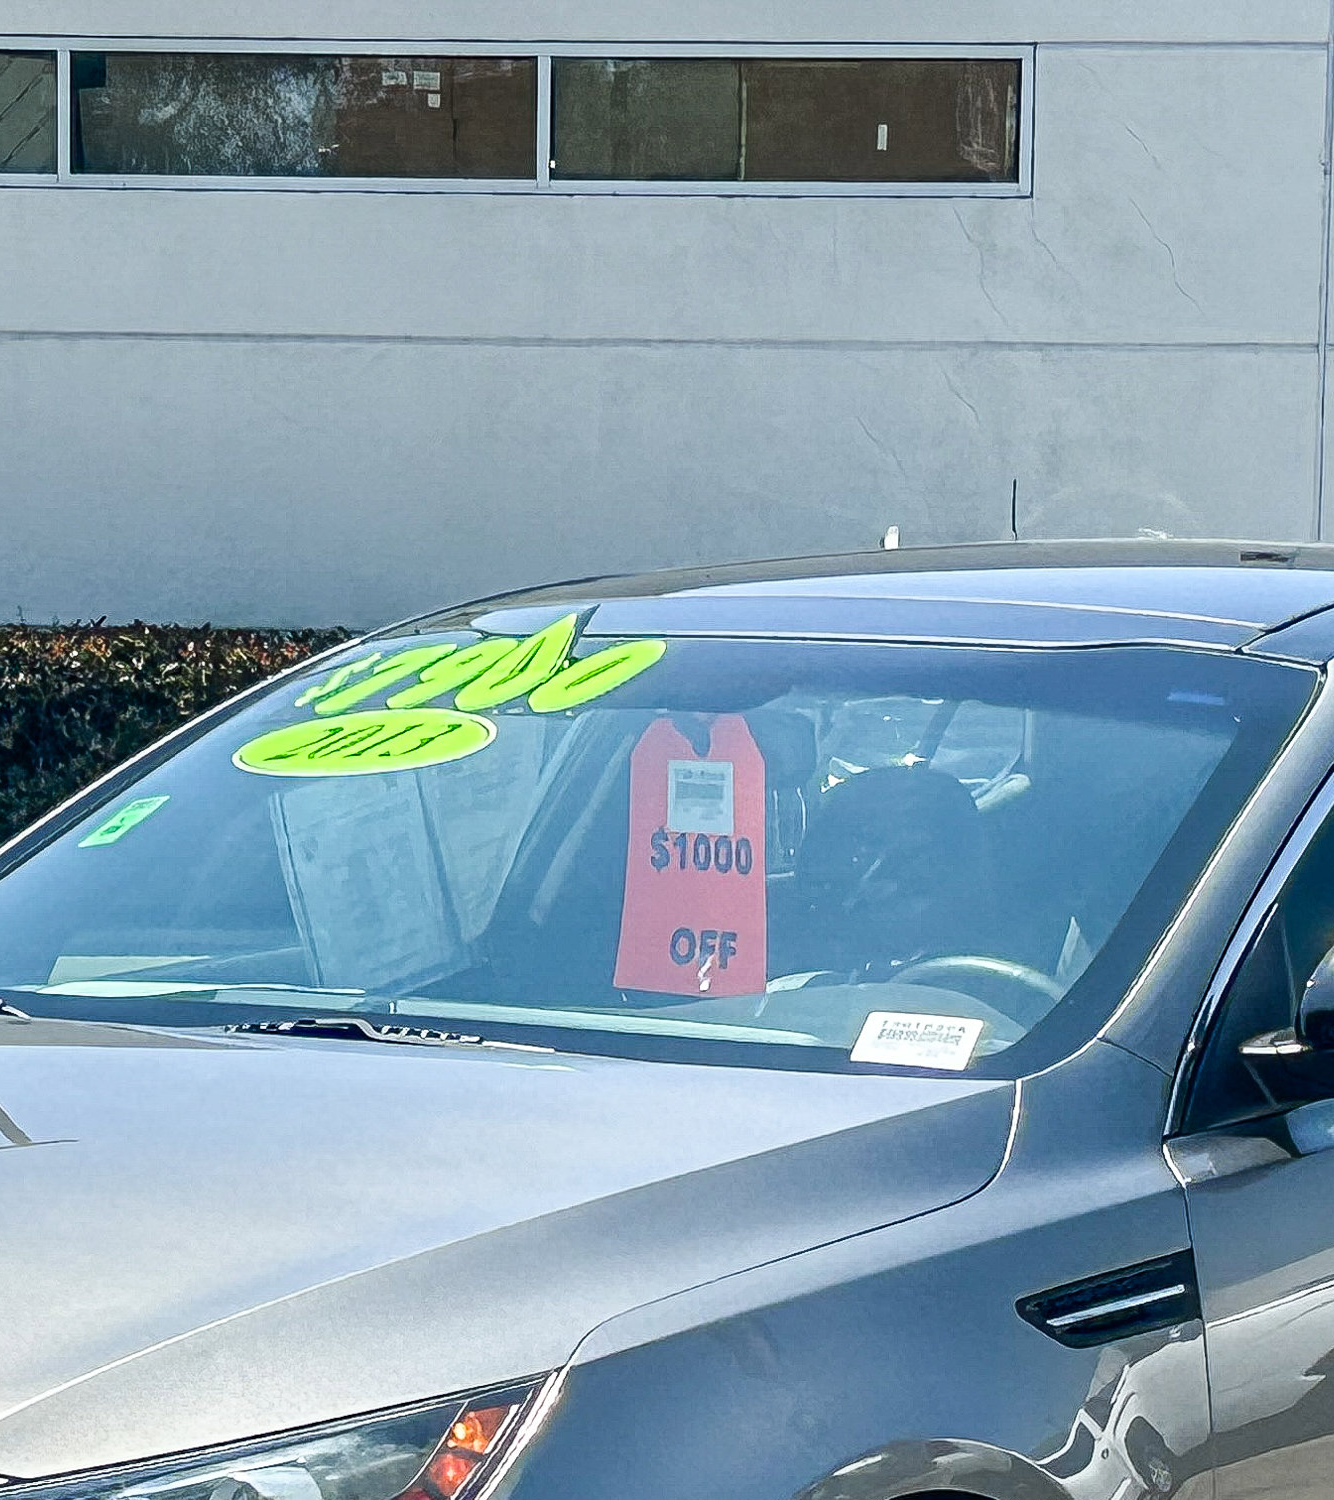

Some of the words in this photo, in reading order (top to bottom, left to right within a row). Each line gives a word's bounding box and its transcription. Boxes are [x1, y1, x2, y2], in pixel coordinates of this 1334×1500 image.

[263, 722, 463, 763] 2013
[650, 826, 753, 875] $1000
[670, 927, 738, 970] OFF
